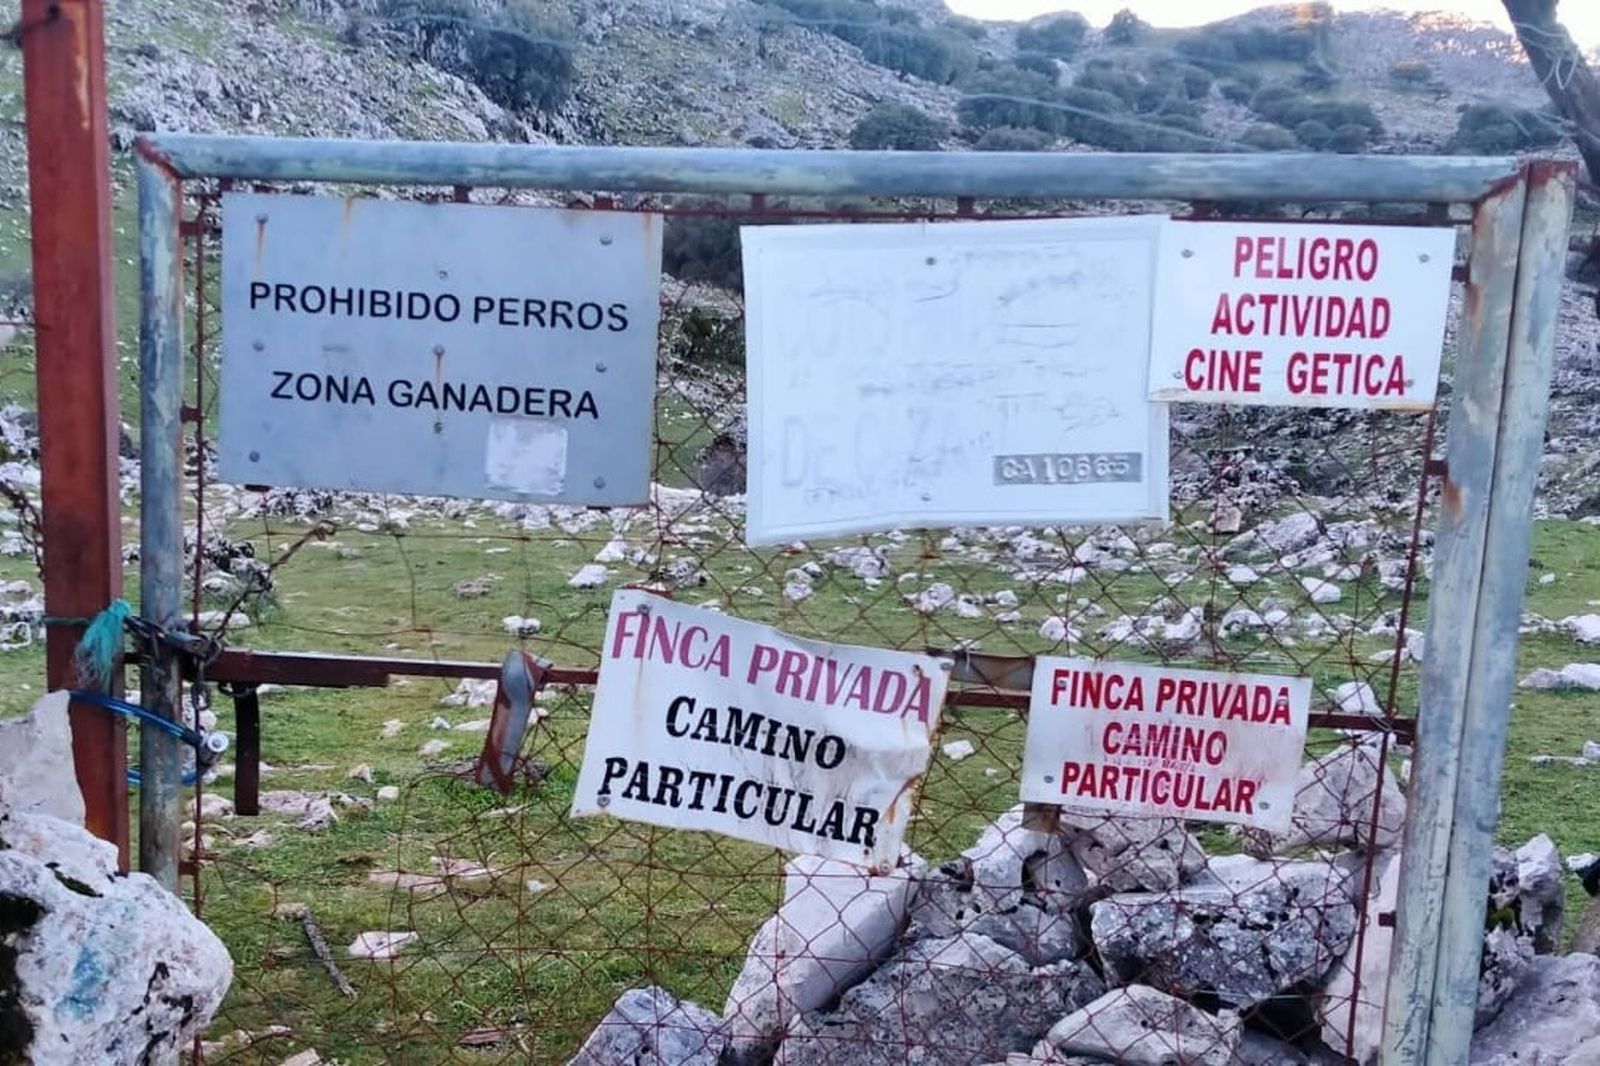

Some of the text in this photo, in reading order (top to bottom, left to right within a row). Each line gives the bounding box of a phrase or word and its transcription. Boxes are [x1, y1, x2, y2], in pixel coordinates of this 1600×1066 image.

[1234, 236, 1379, 281] PELIGRO
[250, 281, 629, 332] PROHIBIDO PERROS
[1211, 293, 1391, 339] ACTIVIDAD
[271, 371, 599, 419] ZONA GANADERA
[1185, 349, 1405, 396] CINE GETICA
[611, 611, 933, 722] FINCA PRIVADA
[1051, 669, 1291, 726] FINCA PRIVADA
[665, 696, 846, 769] CAMINO
[1102, 722, 1227, 765] CAMINO
[597, 757, 880, 847] PARTICULAR
[1061, 761, 1256, 814] PARTICULAR
